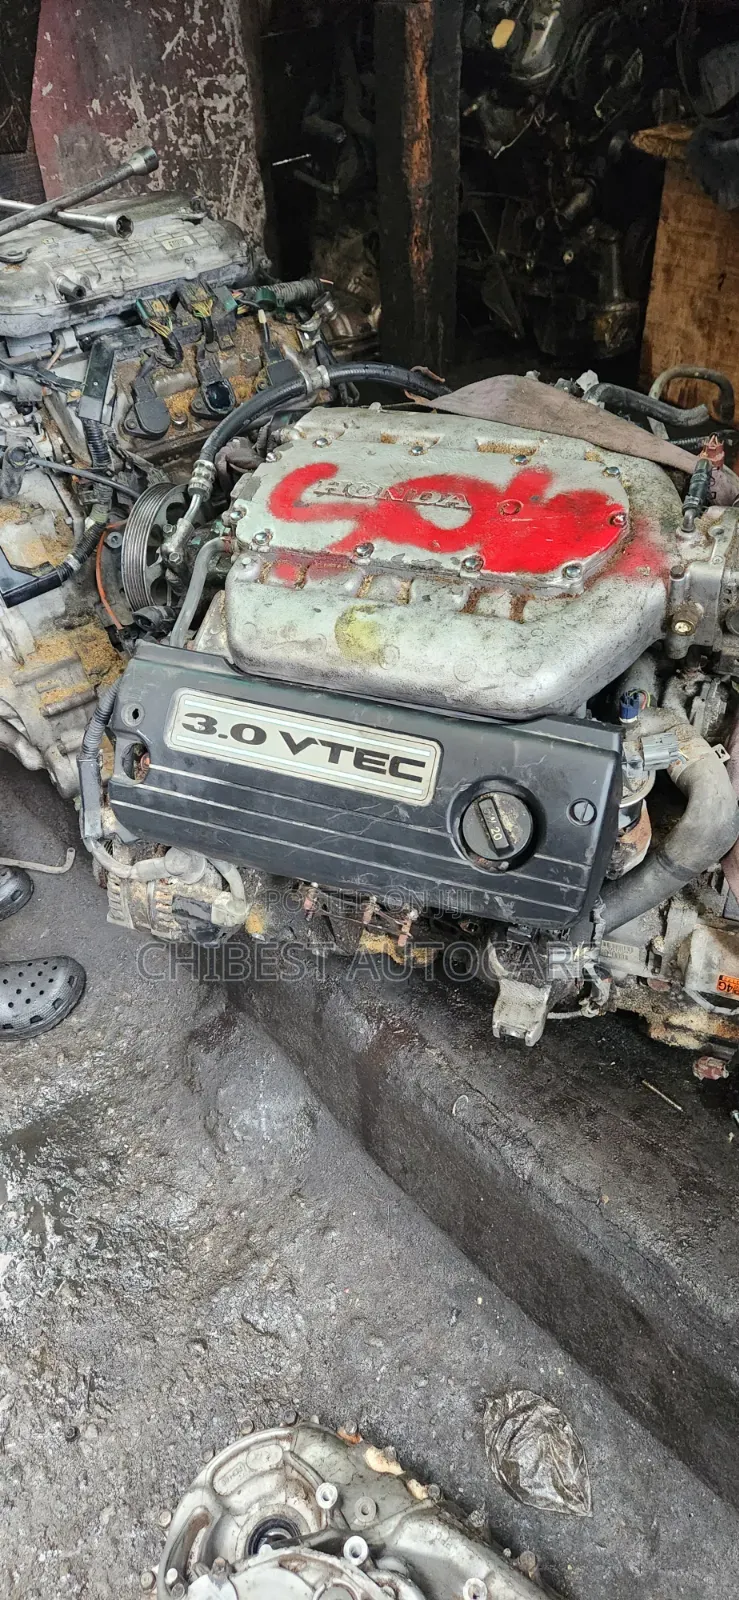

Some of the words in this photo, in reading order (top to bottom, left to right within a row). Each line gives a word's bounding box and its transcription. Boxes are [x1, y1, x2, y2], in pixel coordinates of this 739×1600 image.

[312, 479, 473, 511] HONDA
[181, 712, 267, 746] 3.0
[279, 730, 426, 783] VTEC
